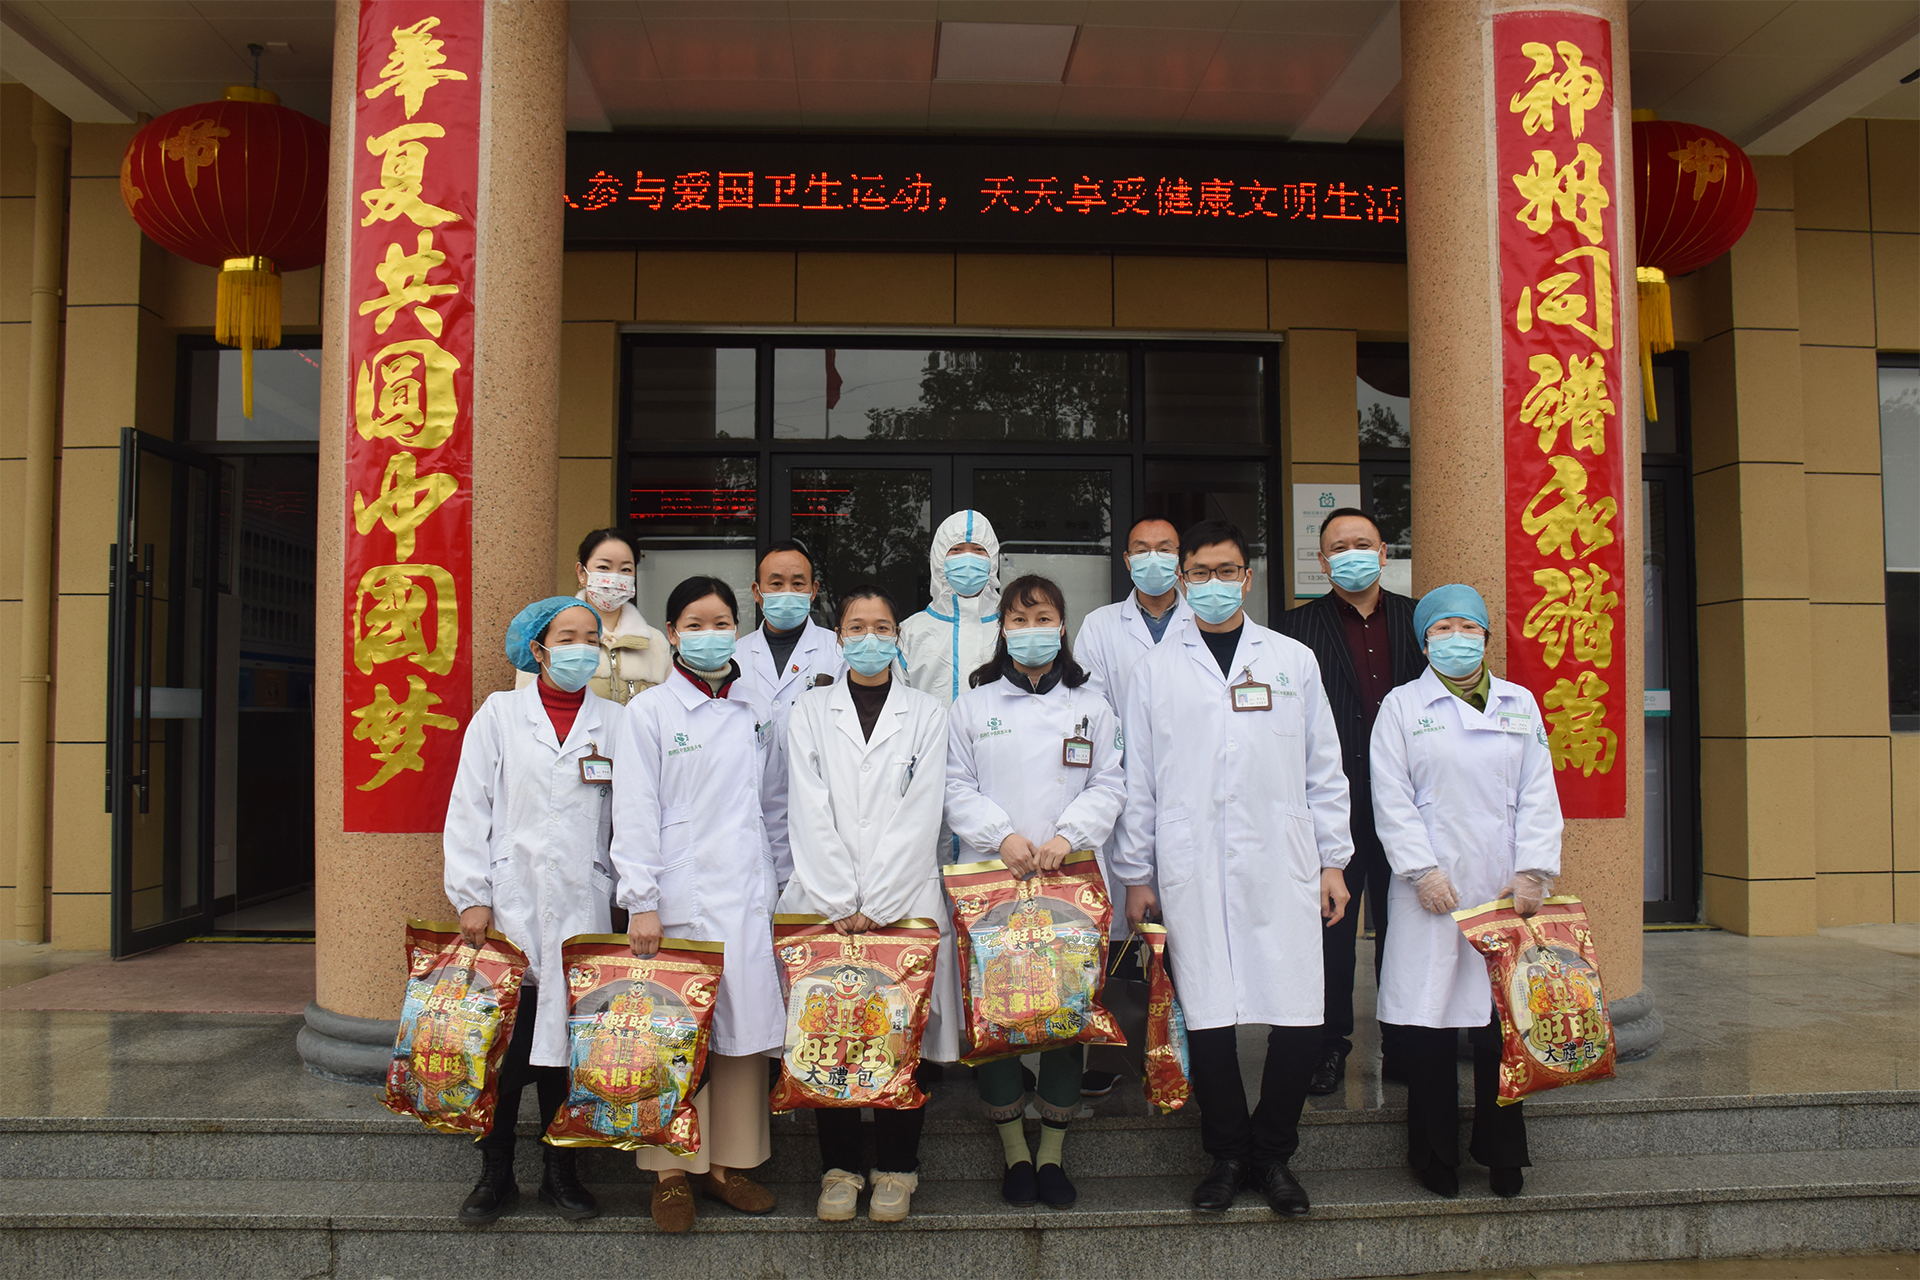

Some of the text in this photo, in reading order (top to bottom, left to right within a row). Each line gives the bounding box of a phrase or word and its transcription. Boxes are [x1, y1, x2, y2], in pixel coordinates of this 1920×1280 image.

[563, 170, 1402, 223] 参与爱国卫生运动，天天享受健康文明生活
[1537, 1010, 1598, 1044] 旺旺
[803, 1035, 886, 1070] 旺旺
